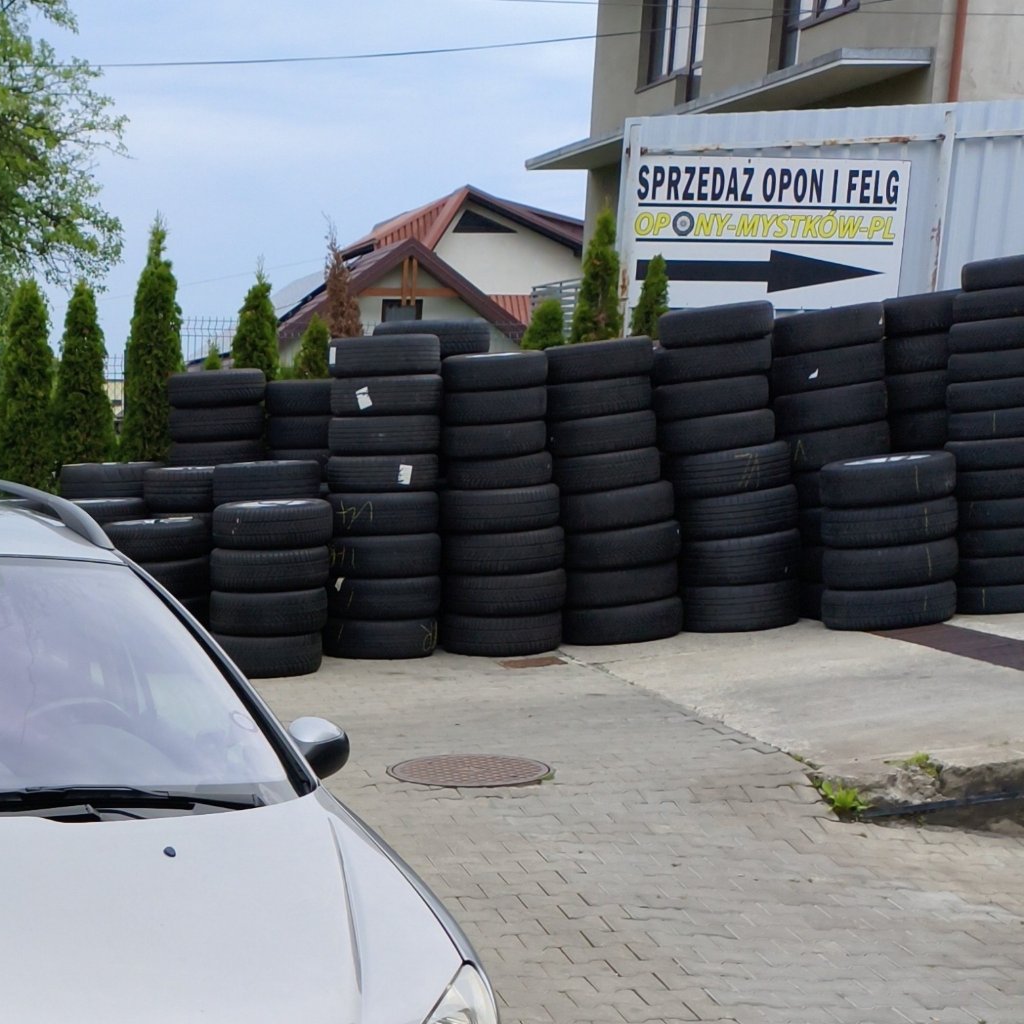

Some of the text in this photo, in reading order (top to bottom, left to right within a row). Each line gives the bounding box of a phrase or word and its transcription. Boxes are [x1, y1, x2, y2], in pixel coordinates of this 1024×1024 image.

[637, 159, 900, 205] SPRZEDAŻ OPON I FELG
